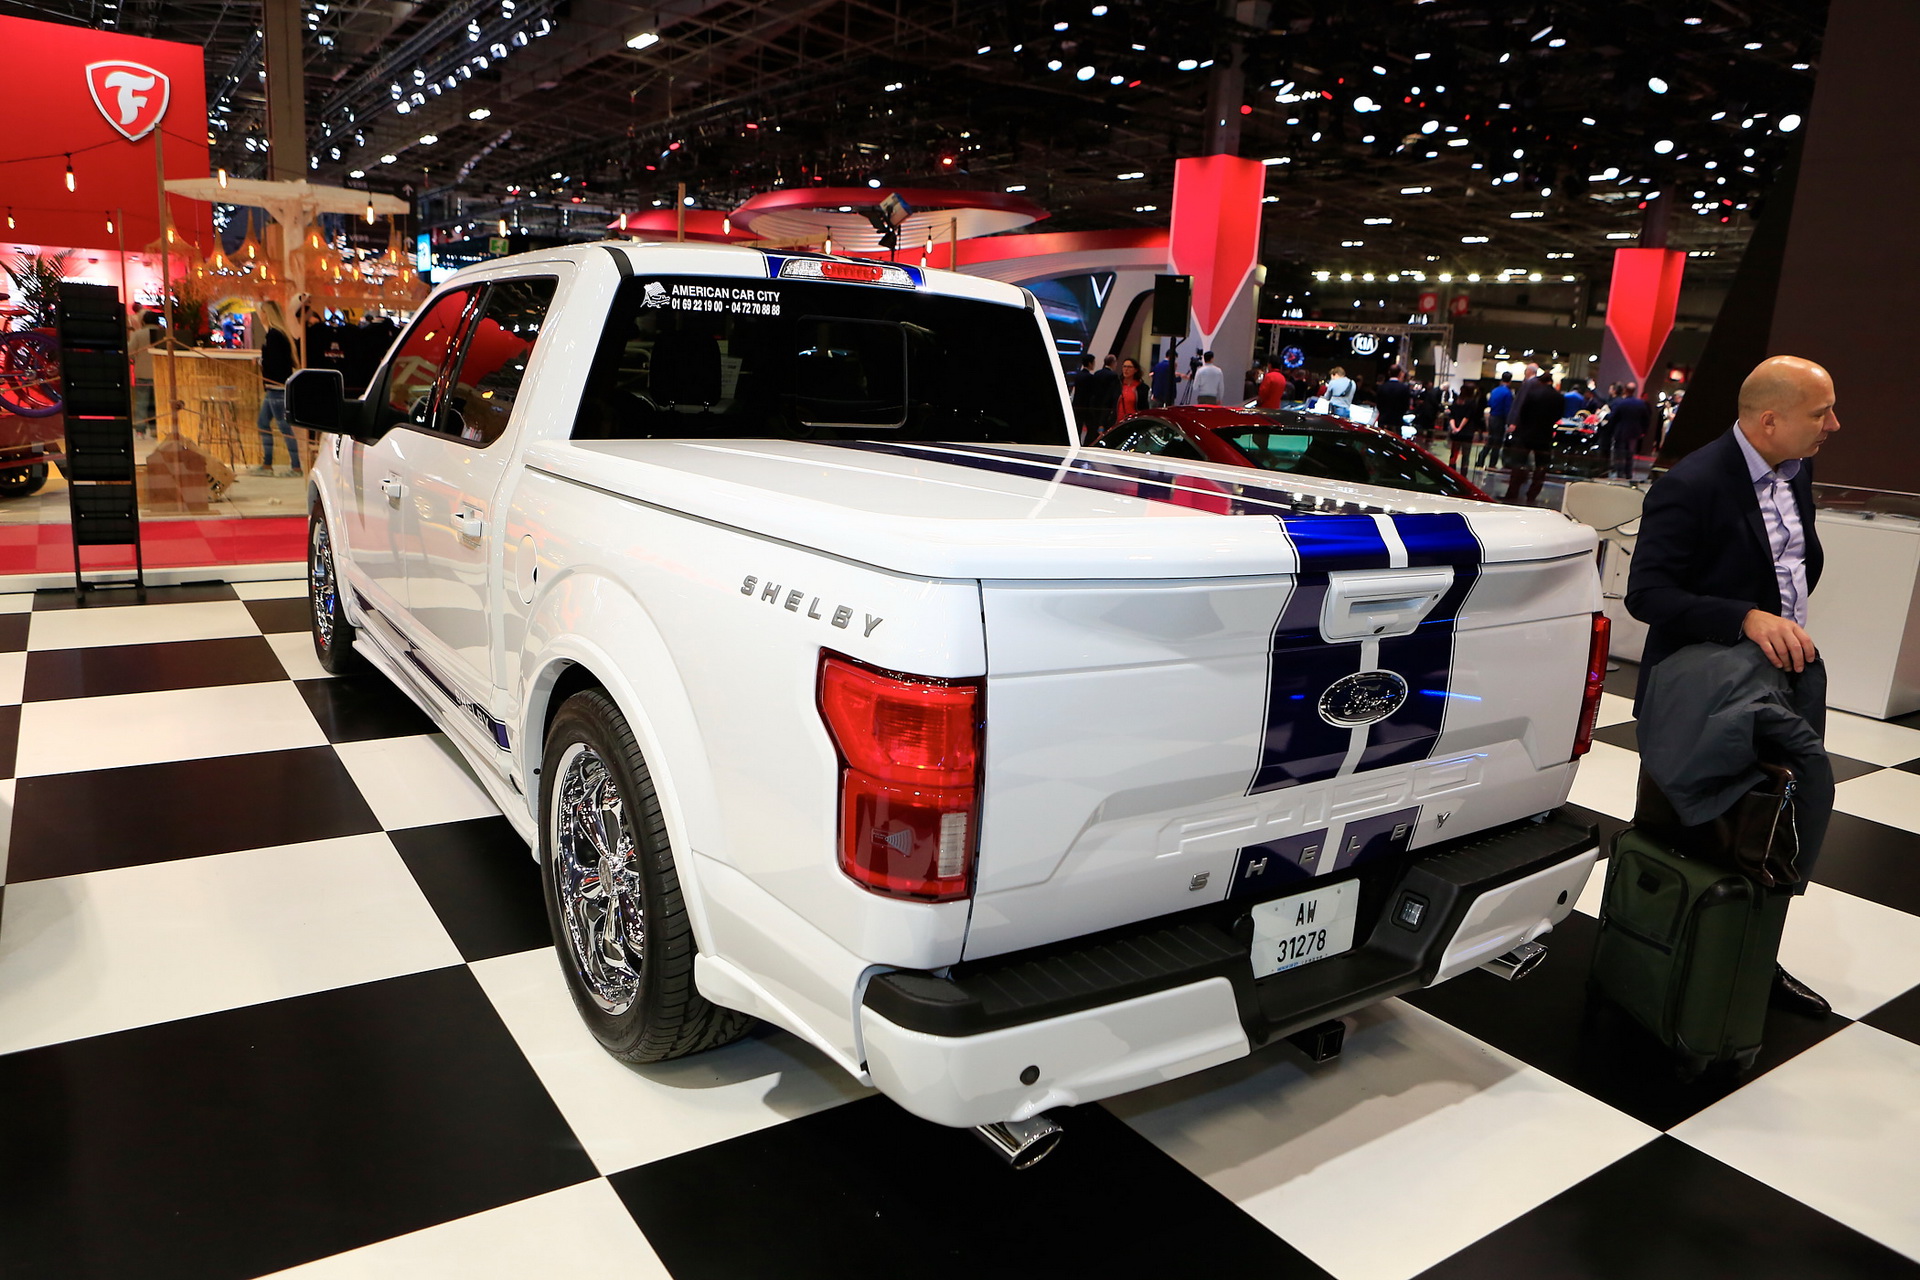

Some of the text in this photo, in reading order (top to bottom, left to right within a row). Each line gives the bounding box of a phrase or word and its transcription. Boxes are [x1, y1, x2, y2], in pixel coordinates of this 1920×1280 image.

[671, 298, 681, 310] 01
[682, 299, 692, 310] 69
[692, 299, 703, 311] 22
[703, 301, 713, 312] 19
[713, 301, 723, 312] 00
[731, 302, 742, 314] 04
[742, 303, 752, 314] 72
[752, 303, 762, 315] 70
[761, 304, 772, 316] 88
[771, 304, 781, 316] 88
[672, 285, 781, 302] AMERICAN CAR CITY
[1356, 336, 1374, 351] KIA
[740, 574, 884, 638] SHELBY
[1188, 810, 1452, 892] SHELBY
[1295, 899, 1318, 927] AW
[1276, 928, 1327, 963] 31278
